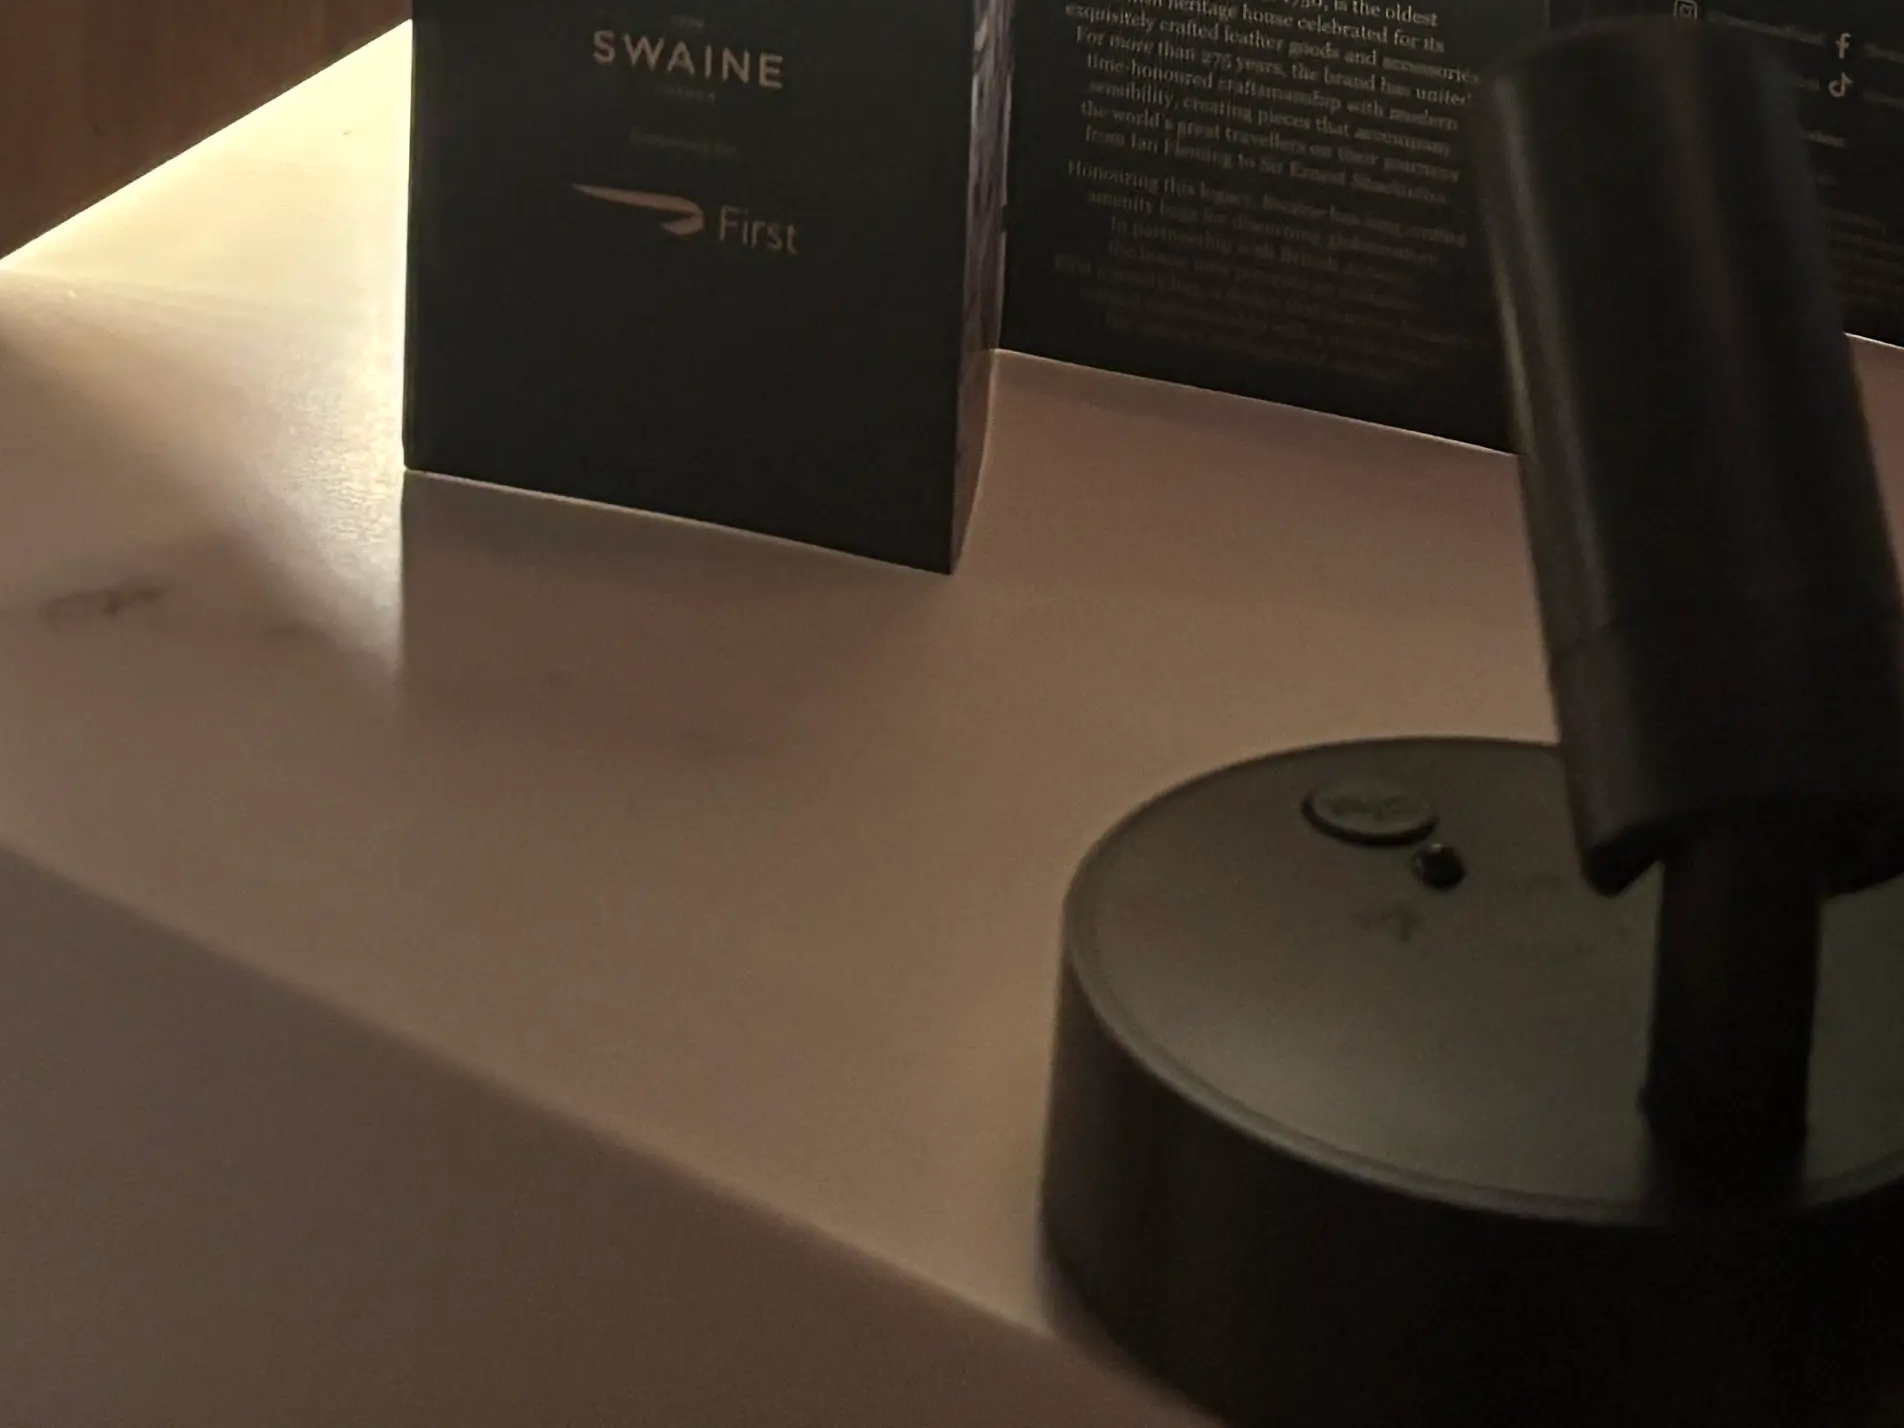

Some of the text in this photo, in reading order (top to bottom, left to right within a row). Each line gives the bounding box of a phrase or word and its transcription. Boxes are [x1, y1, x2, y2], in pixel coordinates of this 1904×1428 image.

[1065, 3, 1155, 33] exquisitely
[1160, 19, 1219, 40] crafted
[1224, 25, 1284, 52] leather
[1343, 49, 1377, 66] and
[1242, 3, 1294, 27] house
[1297, 14, 1388, 44] celebrated
[1394, 28, 1420, 49] for
[1423, 35, 1445, 53] its
[1385, 2, 1438, 27] oldest
[593, 29, 784, 89] SWAINE
[1076, 25, 1104, 46] For
[1109, 33, 1154, 55] more
[1158, 40, 1195, 61] than
[1292, 63, 1319, 82] the
[1324, 64, 1375, 91] brand
[1081, 99, 1109, 118] the
[1087, 53, 1213, 89] time-honoured
[1218, 78, 1341, 115] craftsmanship
[1347, 100, 1384, 117] with
[1183, 97, 1252, 124] creating
[1257, 107, 1310, 130] pieces
[1315, 116, 1350, 137] that
[719, 204, 798, 256] First
